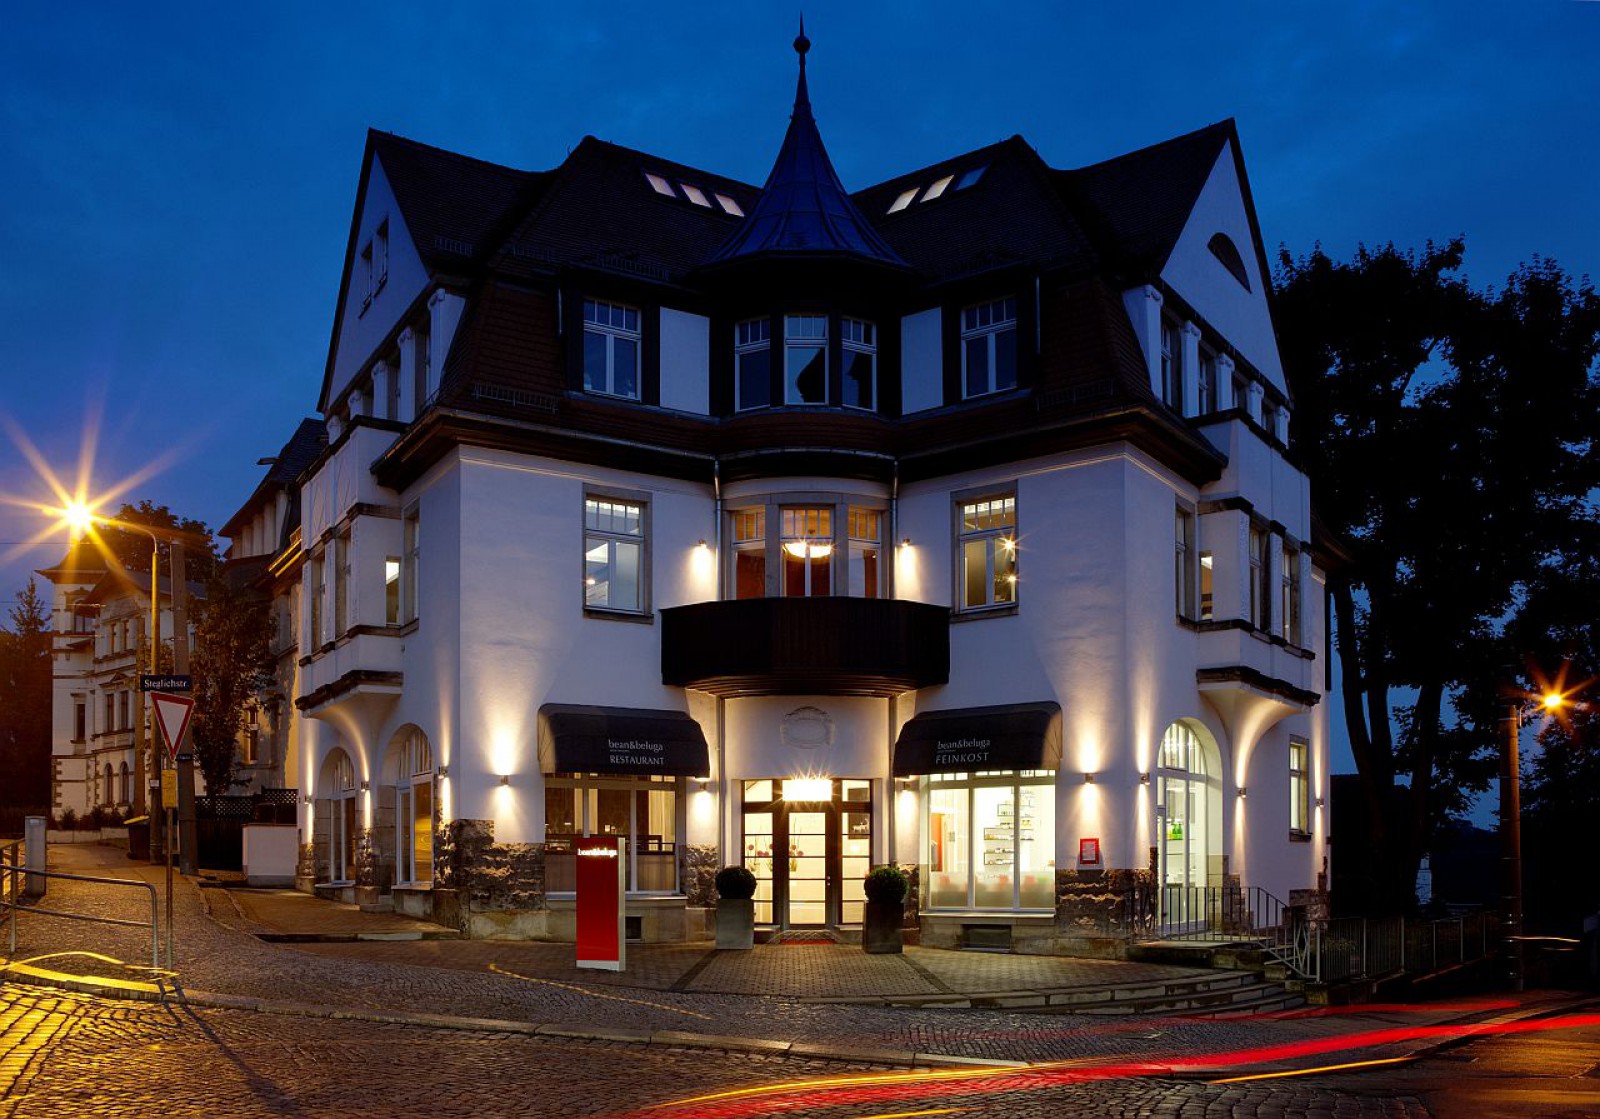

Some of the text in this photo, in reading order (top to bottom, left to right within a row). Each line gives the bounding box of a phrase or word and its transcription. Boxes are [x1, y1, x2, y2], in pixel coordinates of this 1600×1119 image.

[608, 739, 664, 753] bean&beluga
[609, 755, 665, 765] RESTAURANT
[935, 752, 990, 764] FEINKOST
